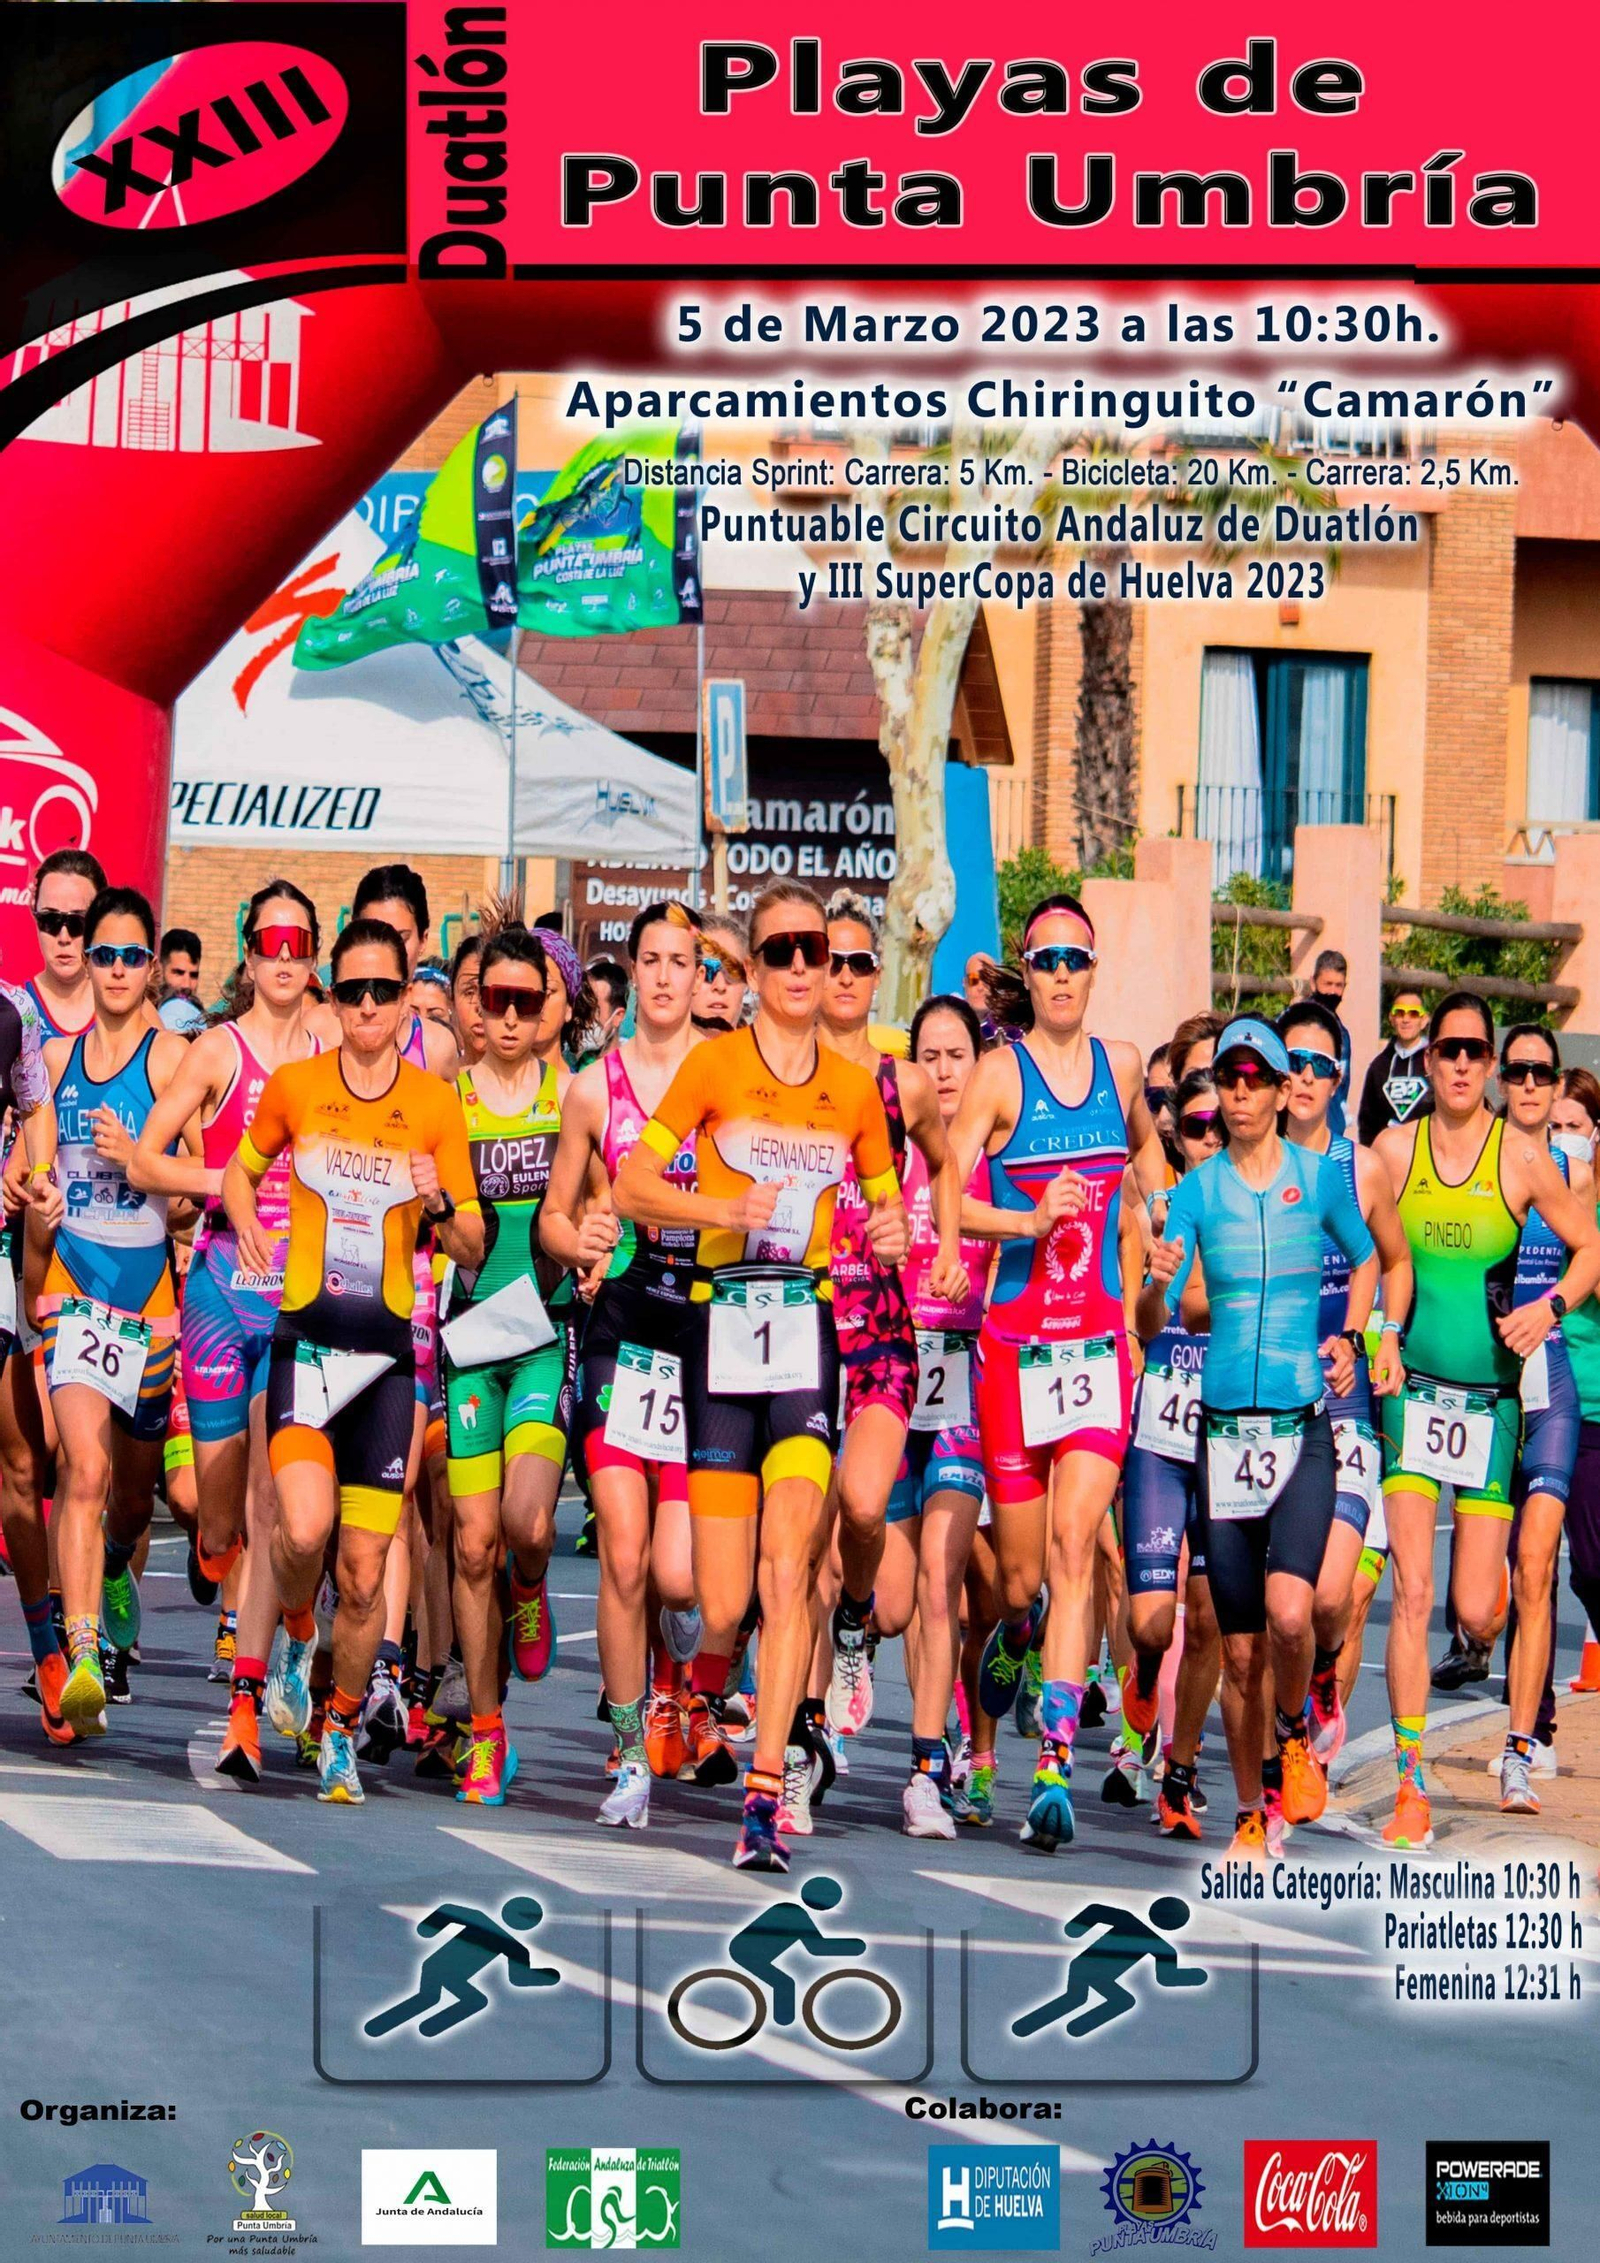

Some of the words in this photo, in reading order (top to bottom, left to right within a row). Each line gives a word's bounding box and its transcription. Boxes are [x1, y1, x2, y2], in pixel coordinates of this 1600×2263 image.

[716, 694, 736, 814] P
[797, 845, 831, 877] EL
[834, 841, 898, 880] AÑO
[479, 1136, 549, 1175] LÓPEZ
[750, 1136, 834, 1175] HERNANDEZ
[1029, 1130, 1120, 1153] CREDUS
[326, 1146, 390, 1187] VAZQUEZ
[512, 1170, 550, 1184] EULEN
[1424, 1221, 1473, 1250] PINEDO
[78, 1329, 124, 1378] 26
[754, 1321, 771, 1366] 1
[640, 1388, 681, 1436] 15
[1049, 1374, 1093, 1416] 13
[1158, 1393, 1203, 1437] 46
[1426, 1416, 1467, 1460] 50
[1234, 1449, 1277, 1491] 43
[1152, 1568, 1175, 1580] EDM
